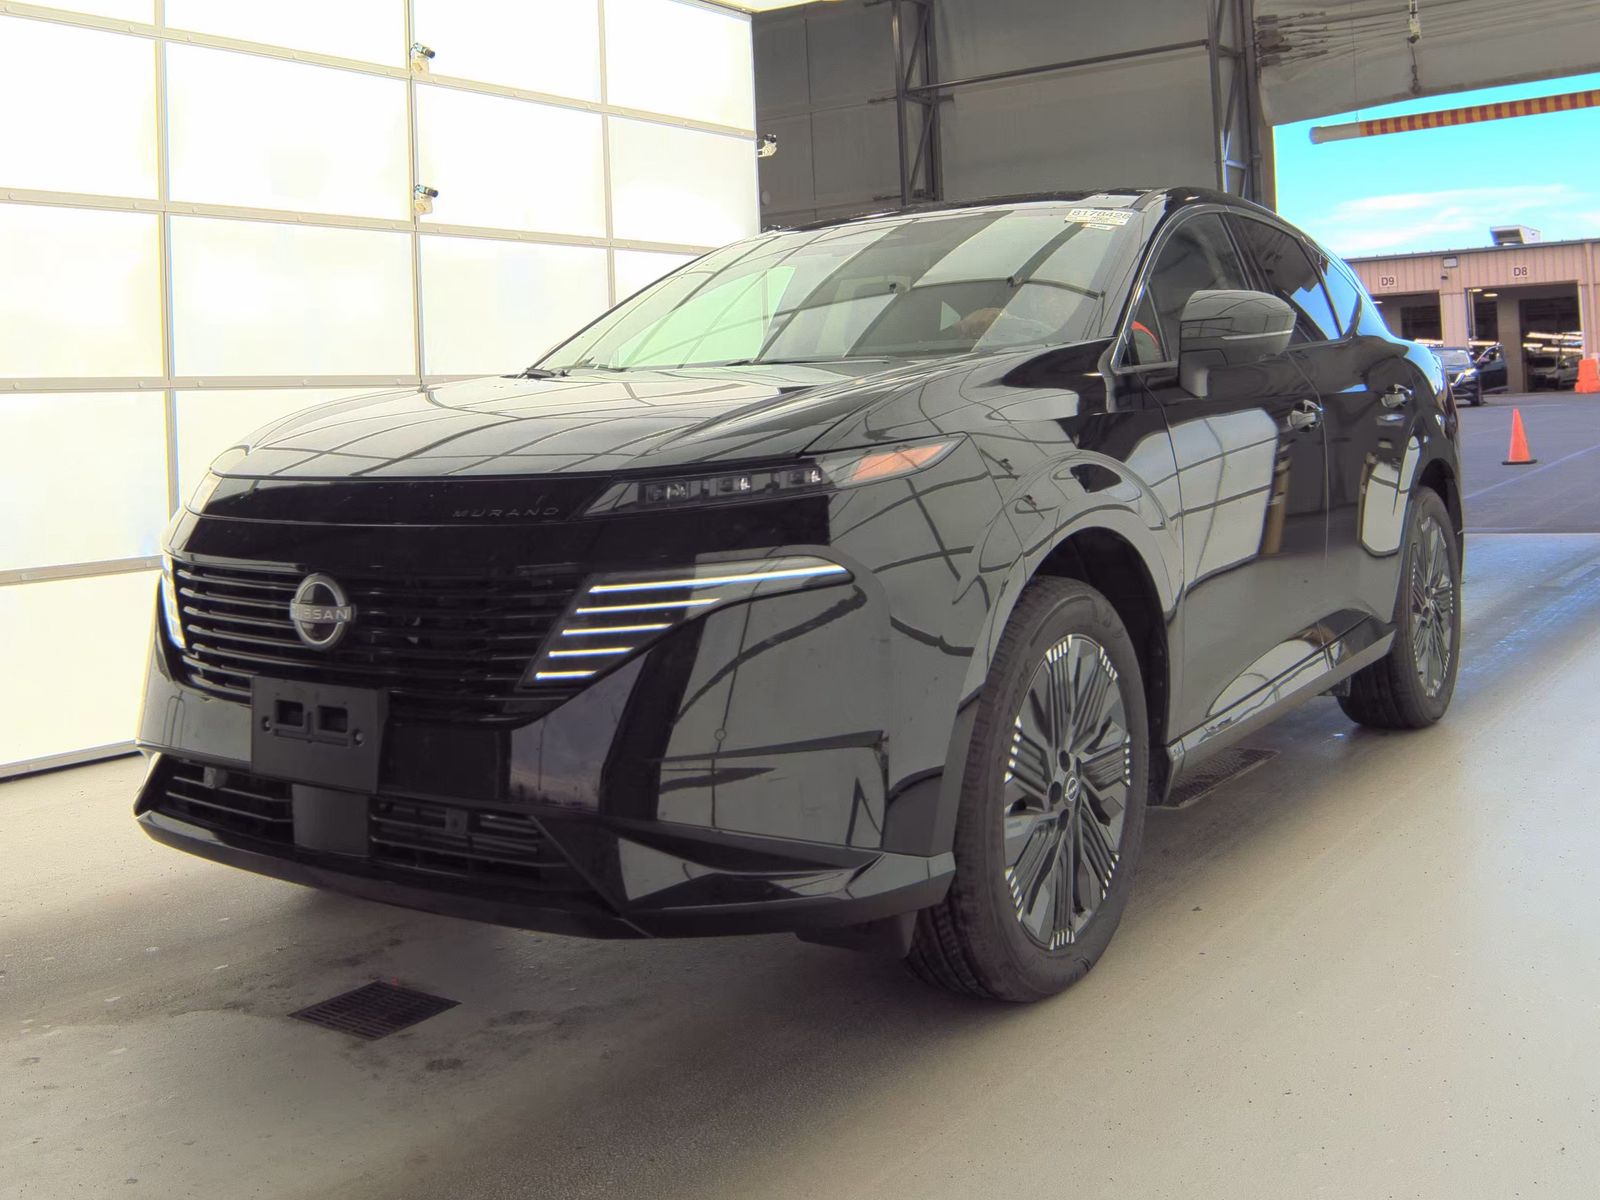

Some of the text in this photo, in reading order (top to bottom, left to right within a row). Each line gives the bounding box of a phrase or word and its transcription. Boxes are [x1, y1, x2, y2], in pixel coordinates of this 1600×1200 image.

[1513, 267, 1528, 277] D8
[1381, 277, 1395, 286] D9
[452, 507, 559, 518] MURANO
[290, 606, 349, 620] SSAN
